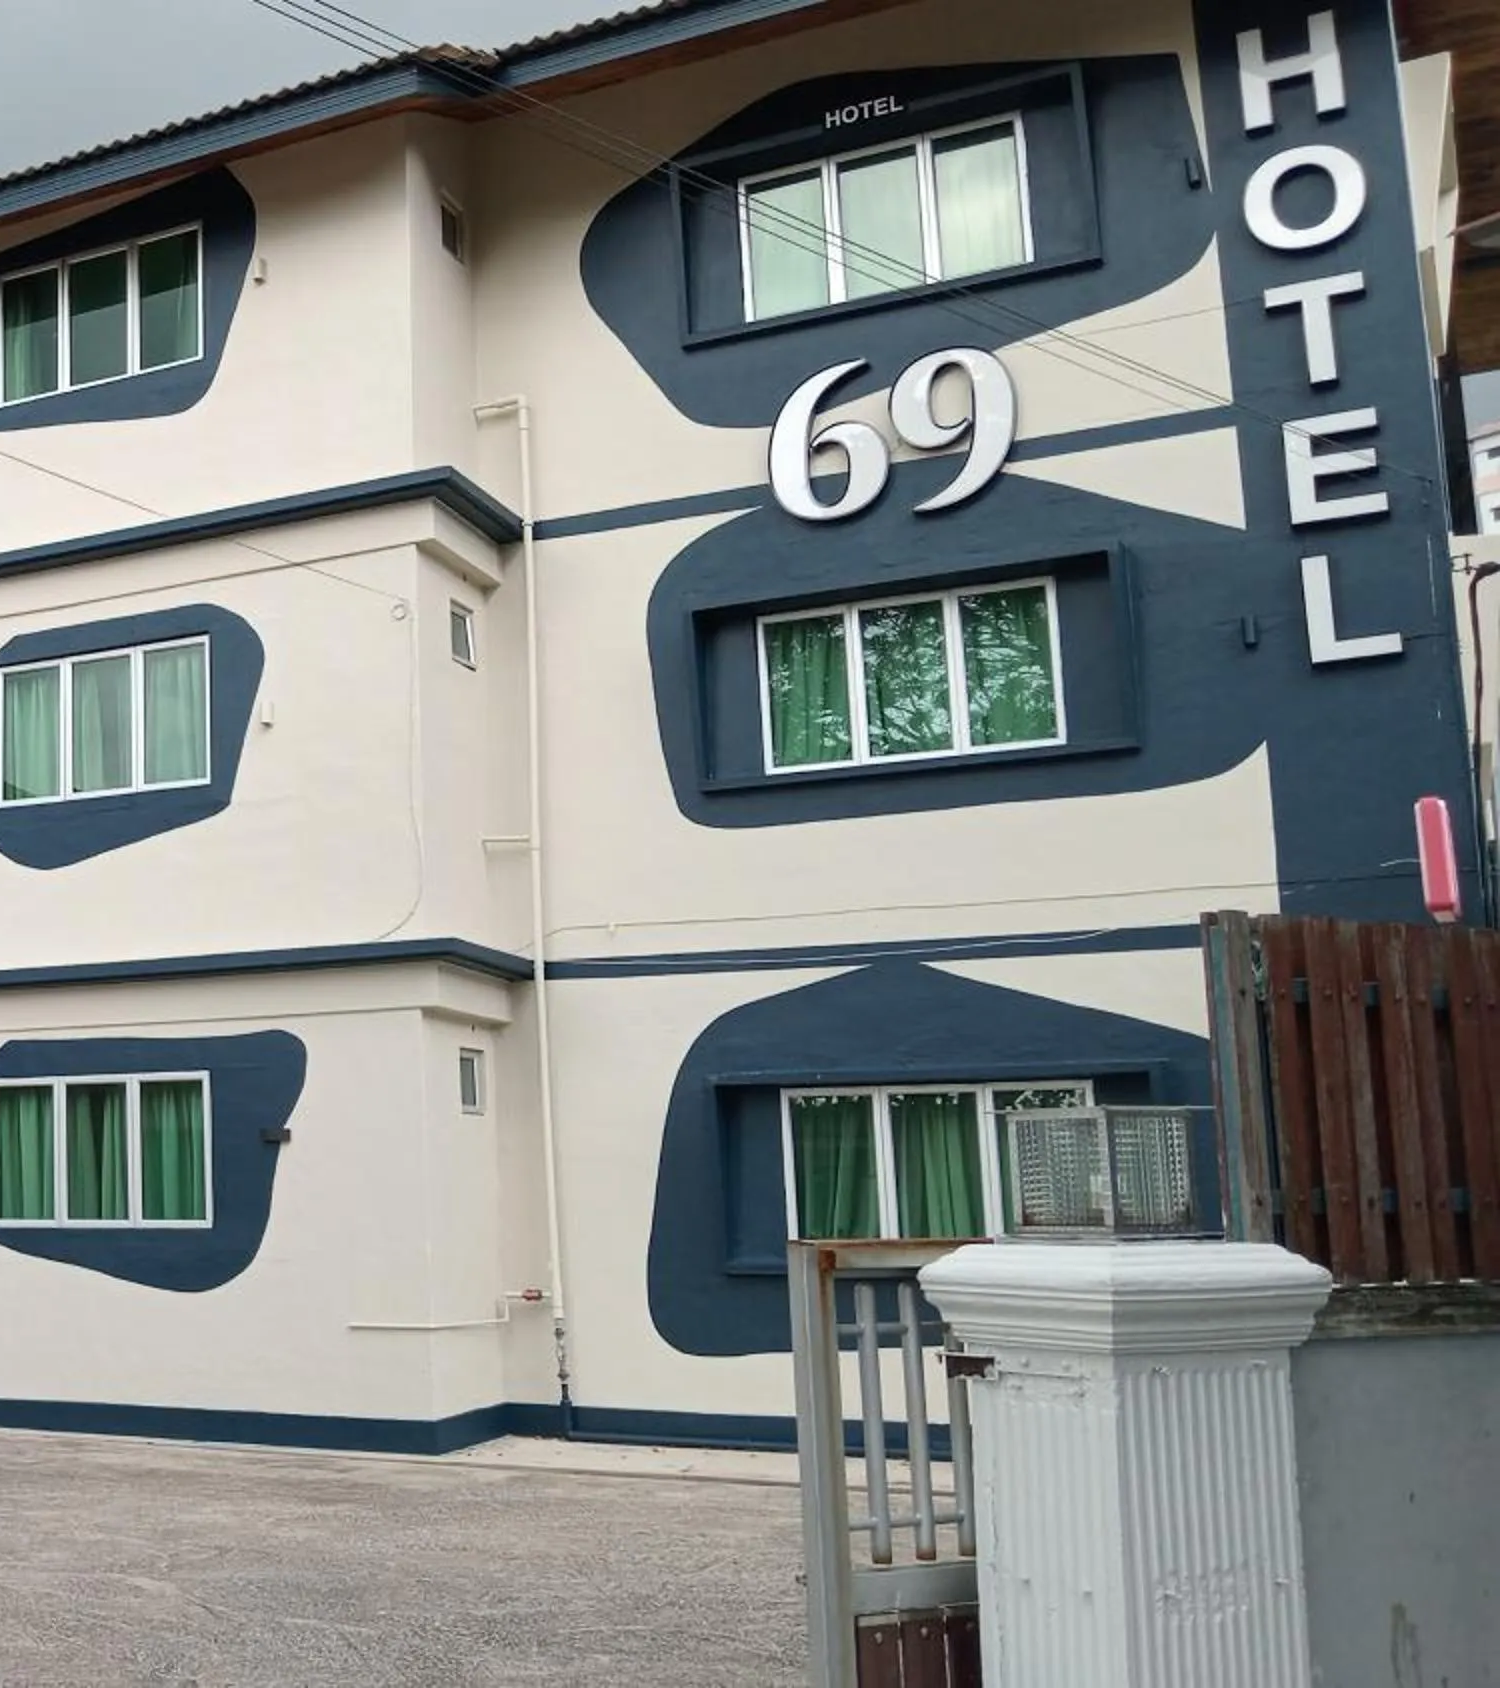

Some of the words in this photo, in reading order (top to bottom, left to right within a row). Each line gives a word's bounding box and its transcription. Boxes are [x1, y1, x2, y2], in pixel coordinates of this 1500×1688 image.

[825, 95, 904, 129] HOTEL
[1236, 9, 1402, 665] HOTEL
[769, 346, 1017, 521] 69
